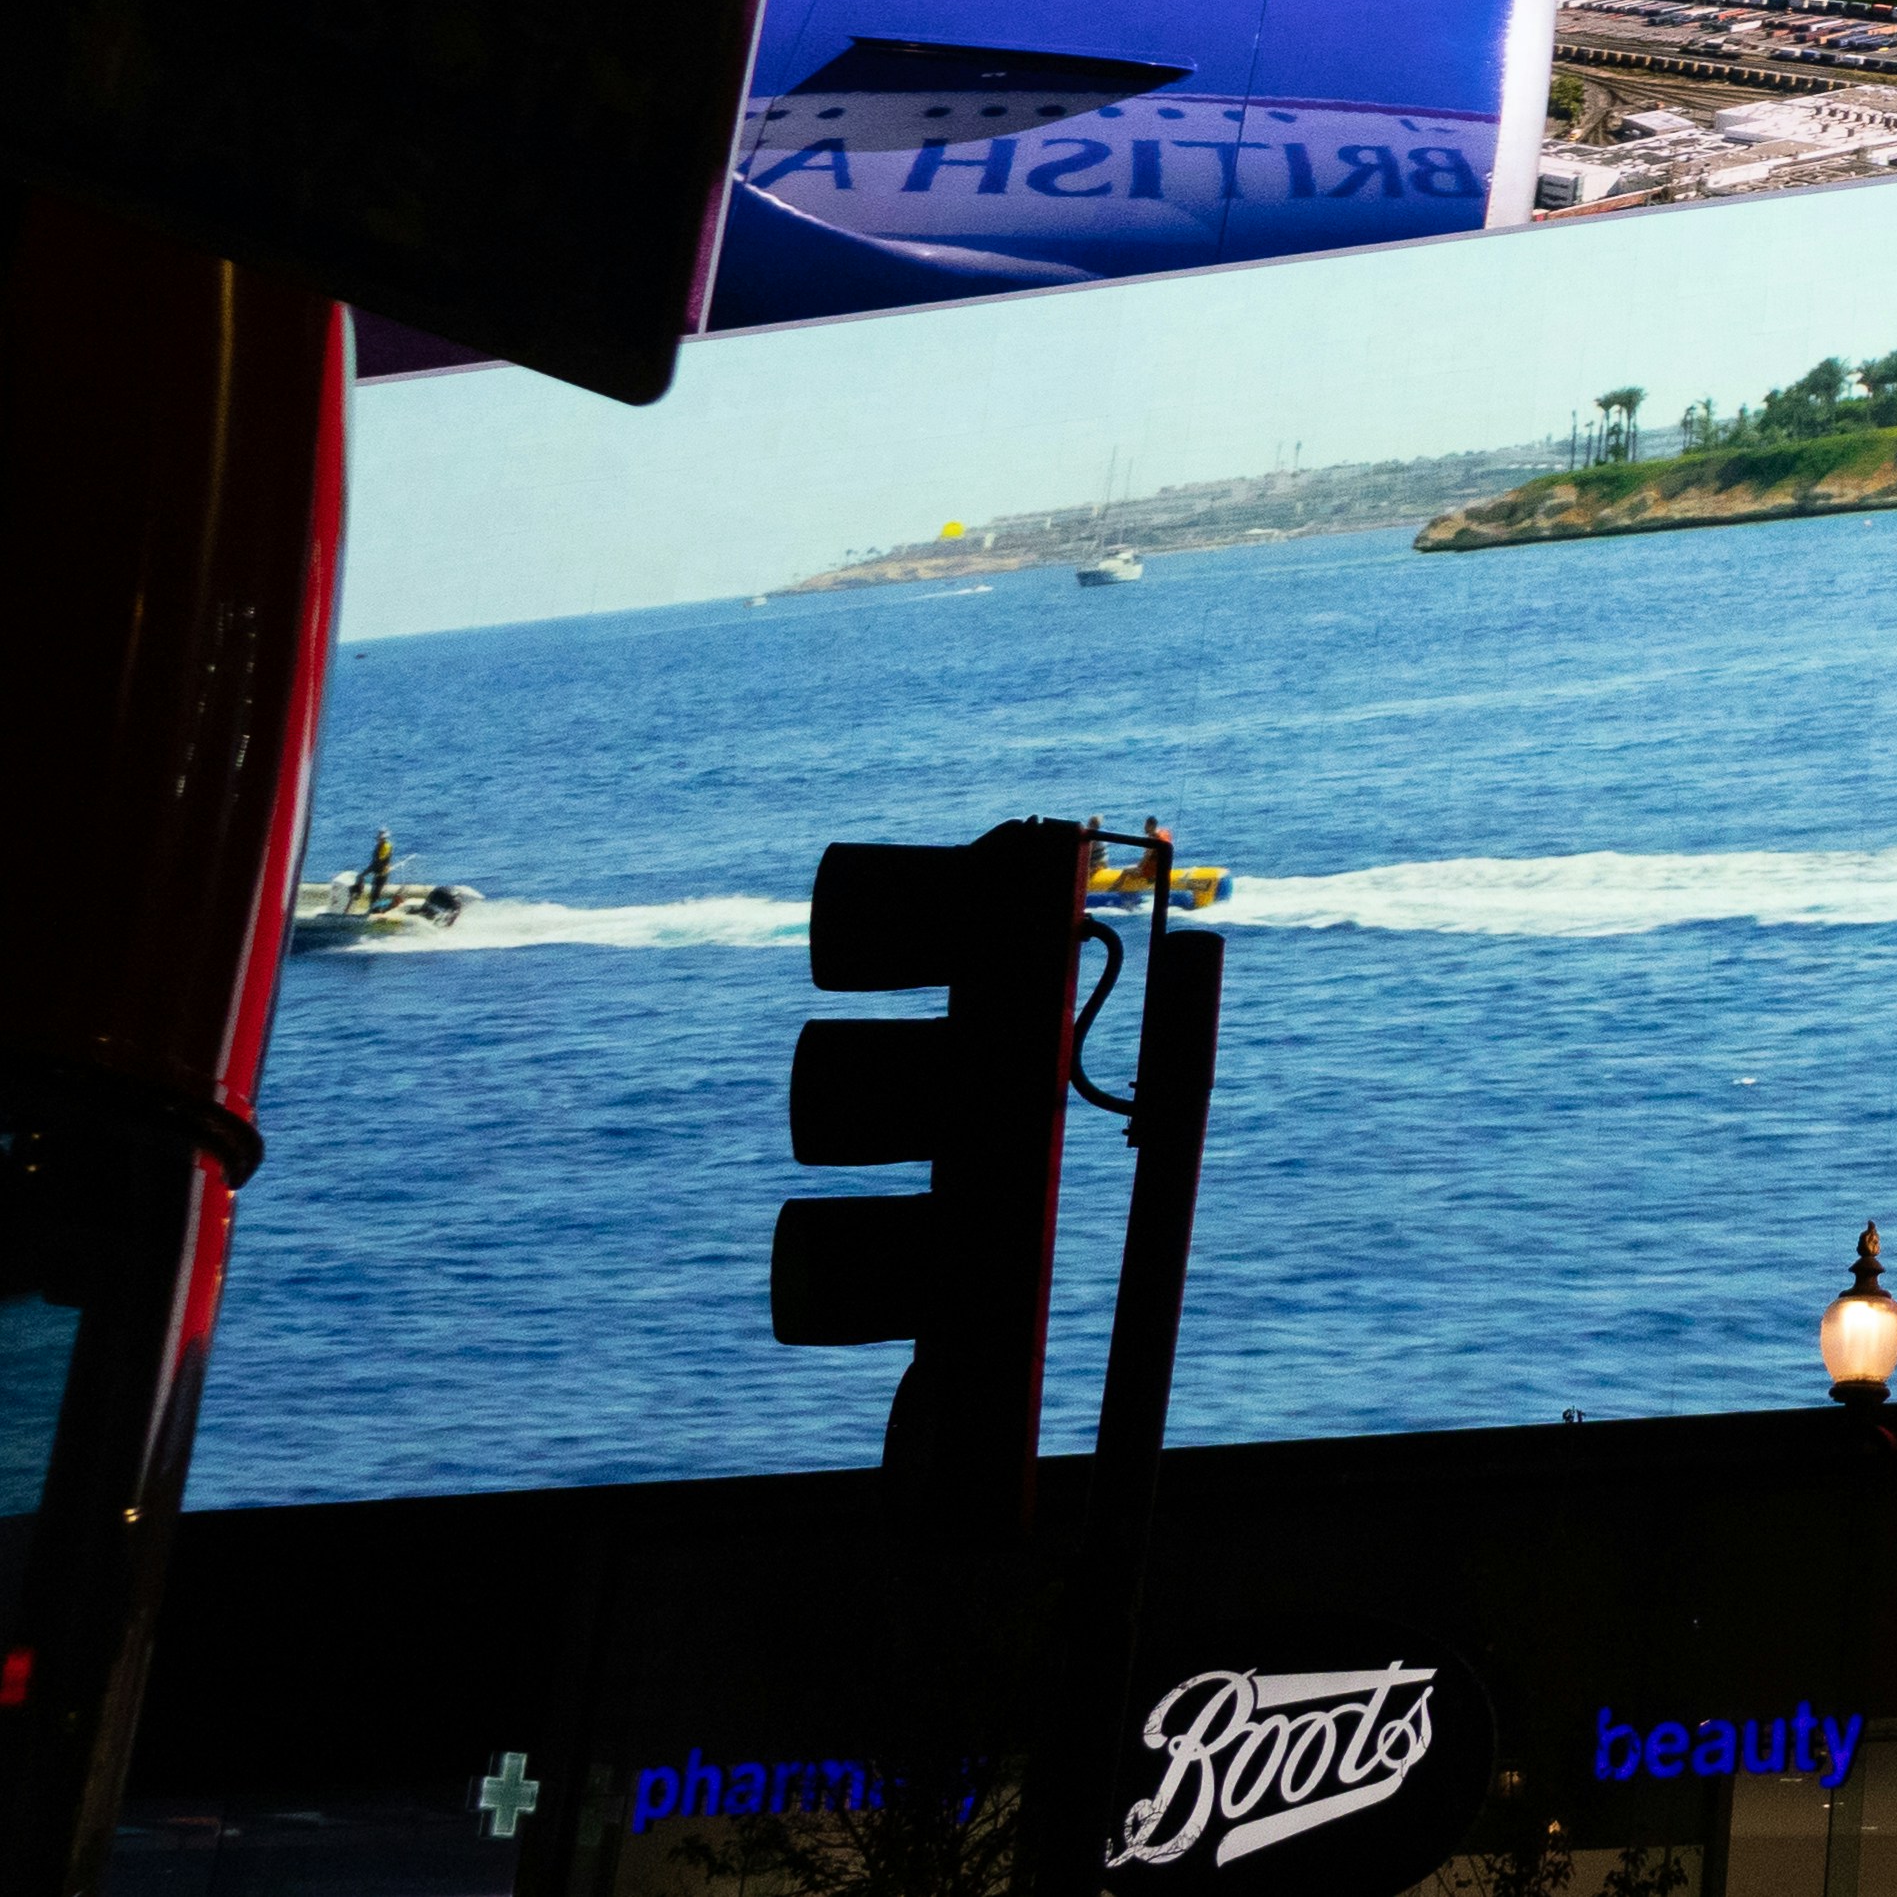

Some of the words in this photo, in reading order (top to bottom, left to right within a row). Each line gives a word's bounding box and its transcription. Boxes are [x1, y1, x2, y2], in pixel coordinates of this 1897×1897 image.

[631, 1745, 989, 1835] pharm
[1105, 1659, 1439, 1869] Boots
[1593, 1699, 1865, 1790] beauty
